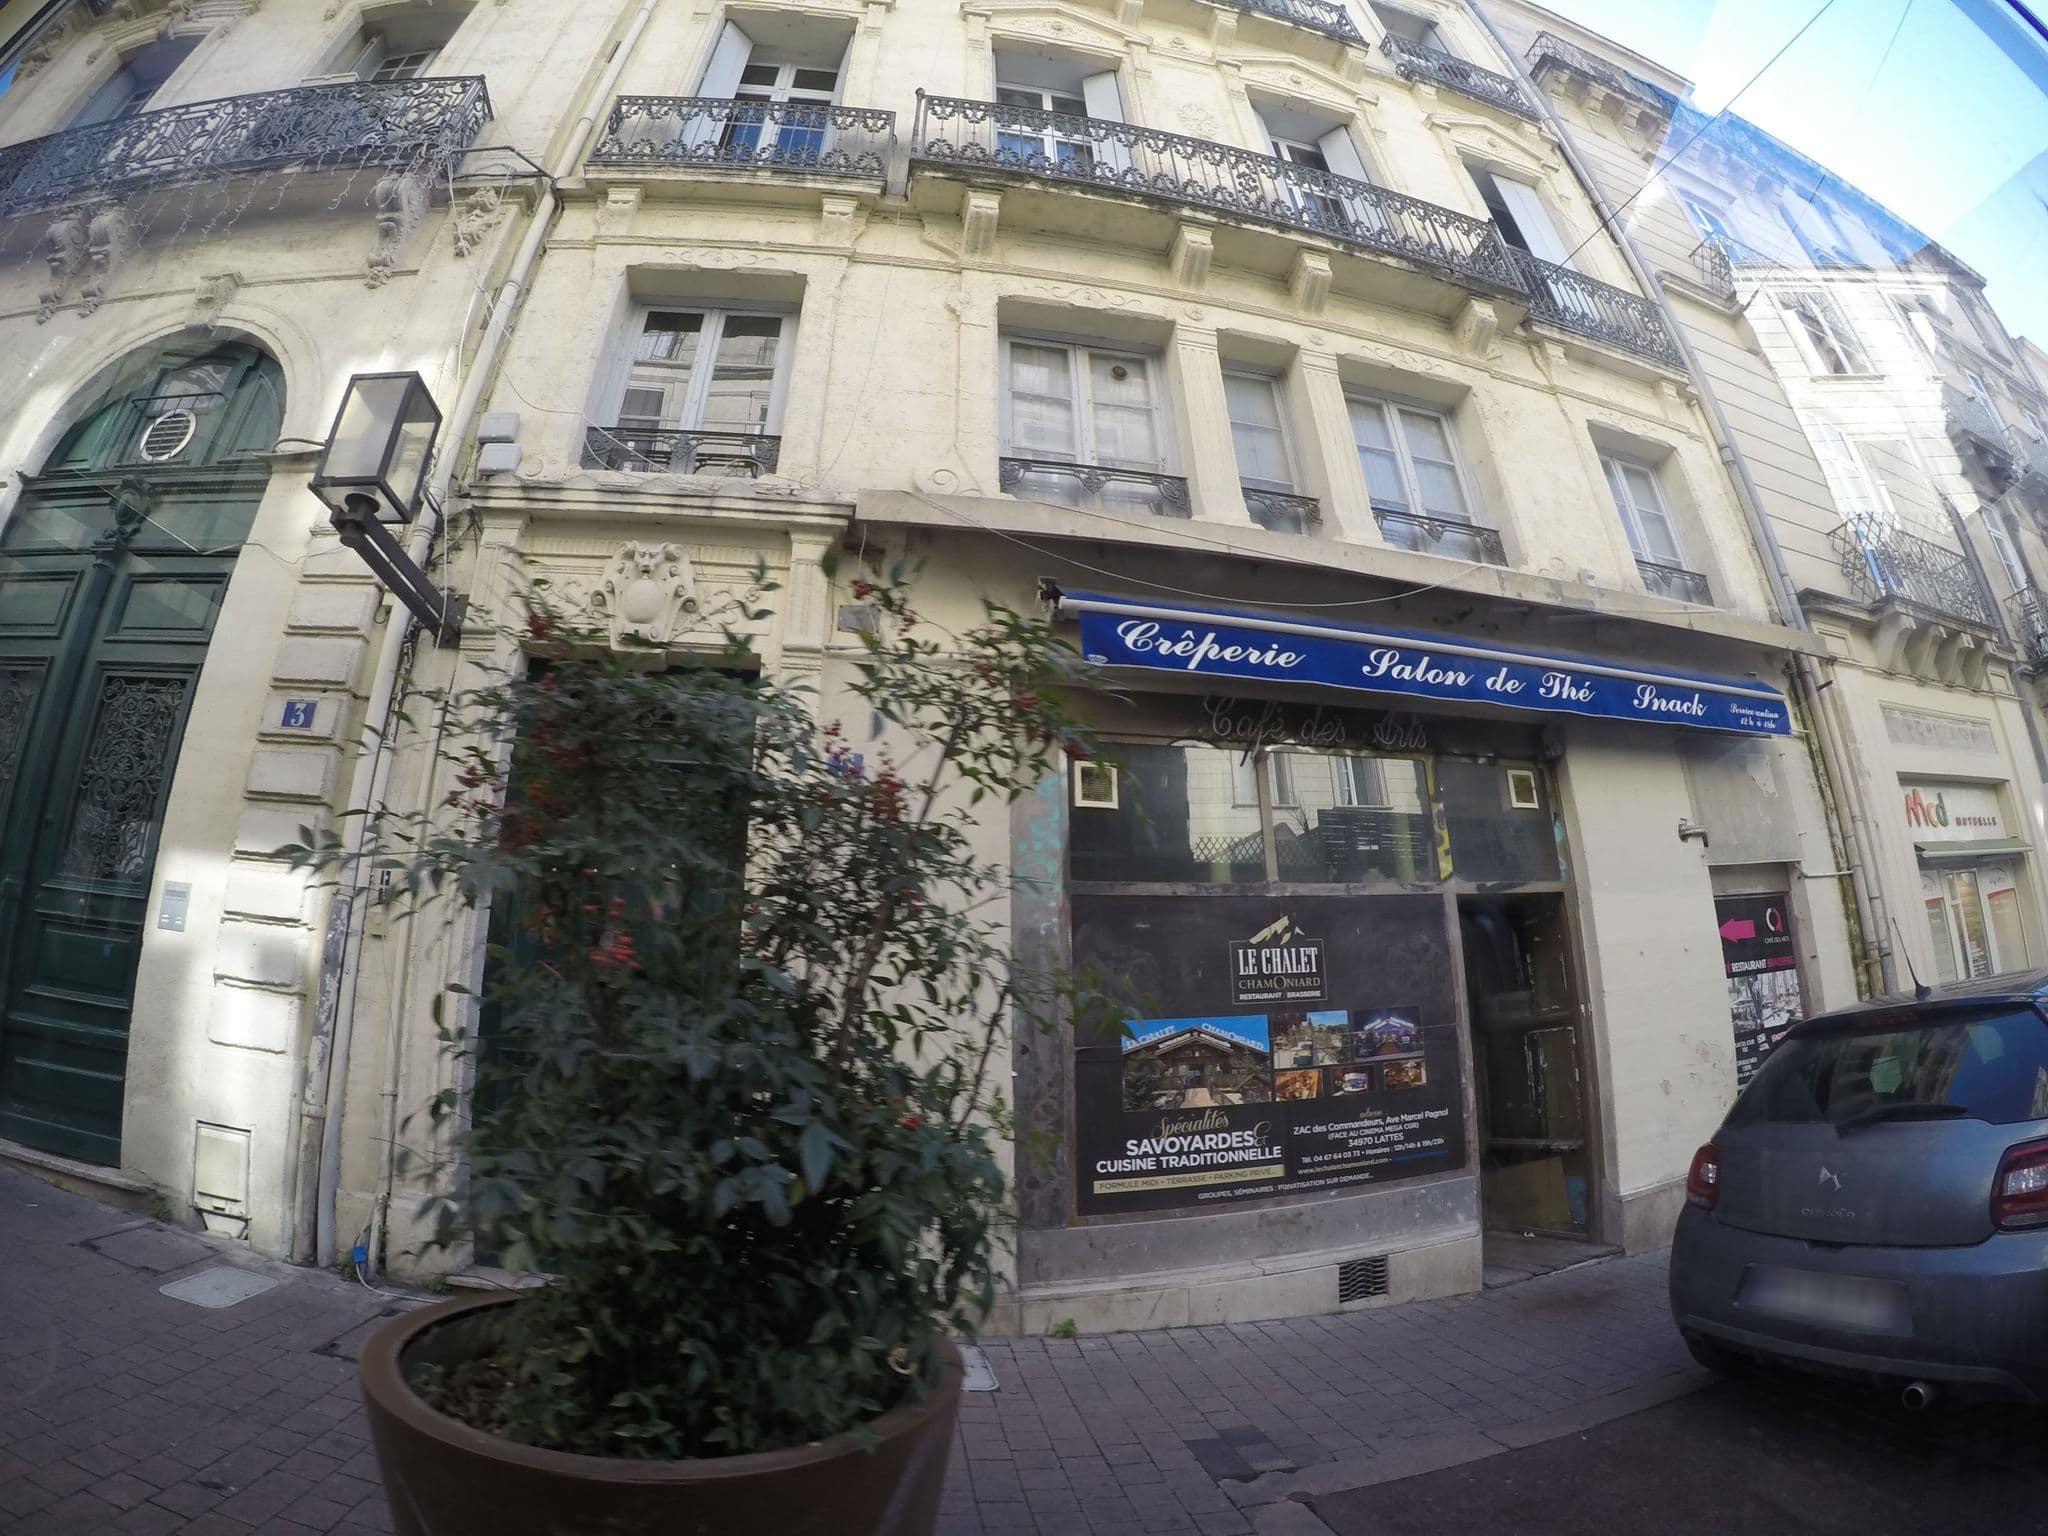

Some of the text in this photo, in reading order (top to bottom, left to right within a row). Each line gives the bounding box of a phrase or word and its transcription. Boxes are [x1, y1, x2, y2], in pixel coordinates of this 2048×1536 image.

[1116, 620, 1307, 670] Crêperie
[1361, 648, 1596, 703] Salon de Thé
[1632, 683, 1709, 717] Snack
[290, 702, 308, 727] 3
[1955, 816, 1998, 827] MUTUELLE
[1238, 947, 1318, 975] LE CHALET
[1731, 958, 1767, 973] RESTAURANT
[1238, 975, 1321, 990] CHAMONIARD
[1239, 990, 1321, 1000] RESTAURANT BRASSERIE
[1154, 1108, 1229, 1139] Spécialités
[1293, 1125, 1312, 1135] ZAC
[1312, 1124, 1327, 1133] des
[1400, 1111, 1424, 1122] Marcel
[1424, 1108, 1449, 1119] Pagnol
[1126, 1130, 1255, 1156] SAVOYARDES
[1347, 1132, 1404, 1147] 34970 LATTES
[1096, 1146, 1282, 1174] CUISINE TRADITIONNELLE
[1099, 1180, 1140, 1190] FORMULE
[1166, 1175, 1207, 1186] TERRASSE
